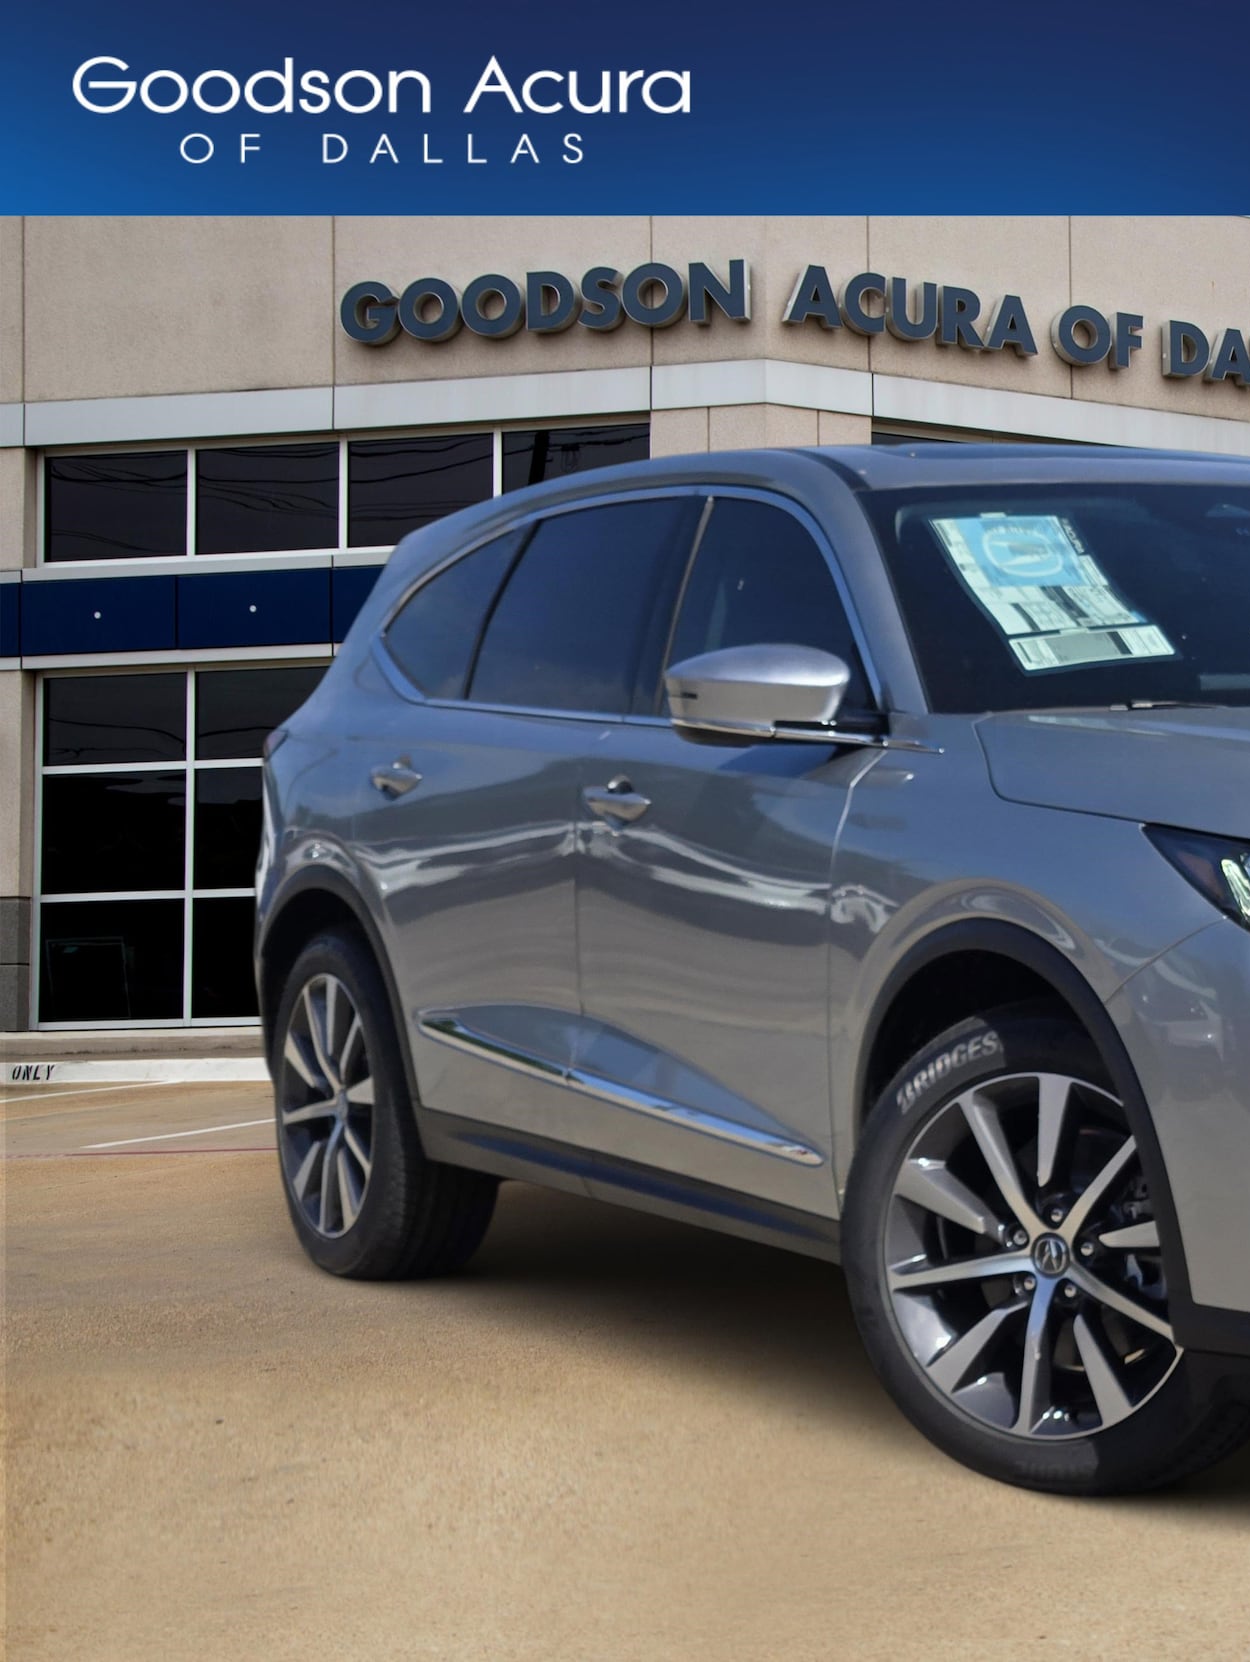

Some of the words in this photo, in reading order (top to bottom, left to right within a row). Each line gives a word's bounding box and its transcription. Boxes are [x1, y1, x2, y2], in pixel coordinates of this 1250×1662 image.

[340, 259, 751, 346] GOODSON
[783, 264, 1038, 356] ACURA
[1051, 304, 1143, 369] OF
[12, 1064, 55, 1081] ONLY
[896, 1030, 1004, 1115] BRIDGES
